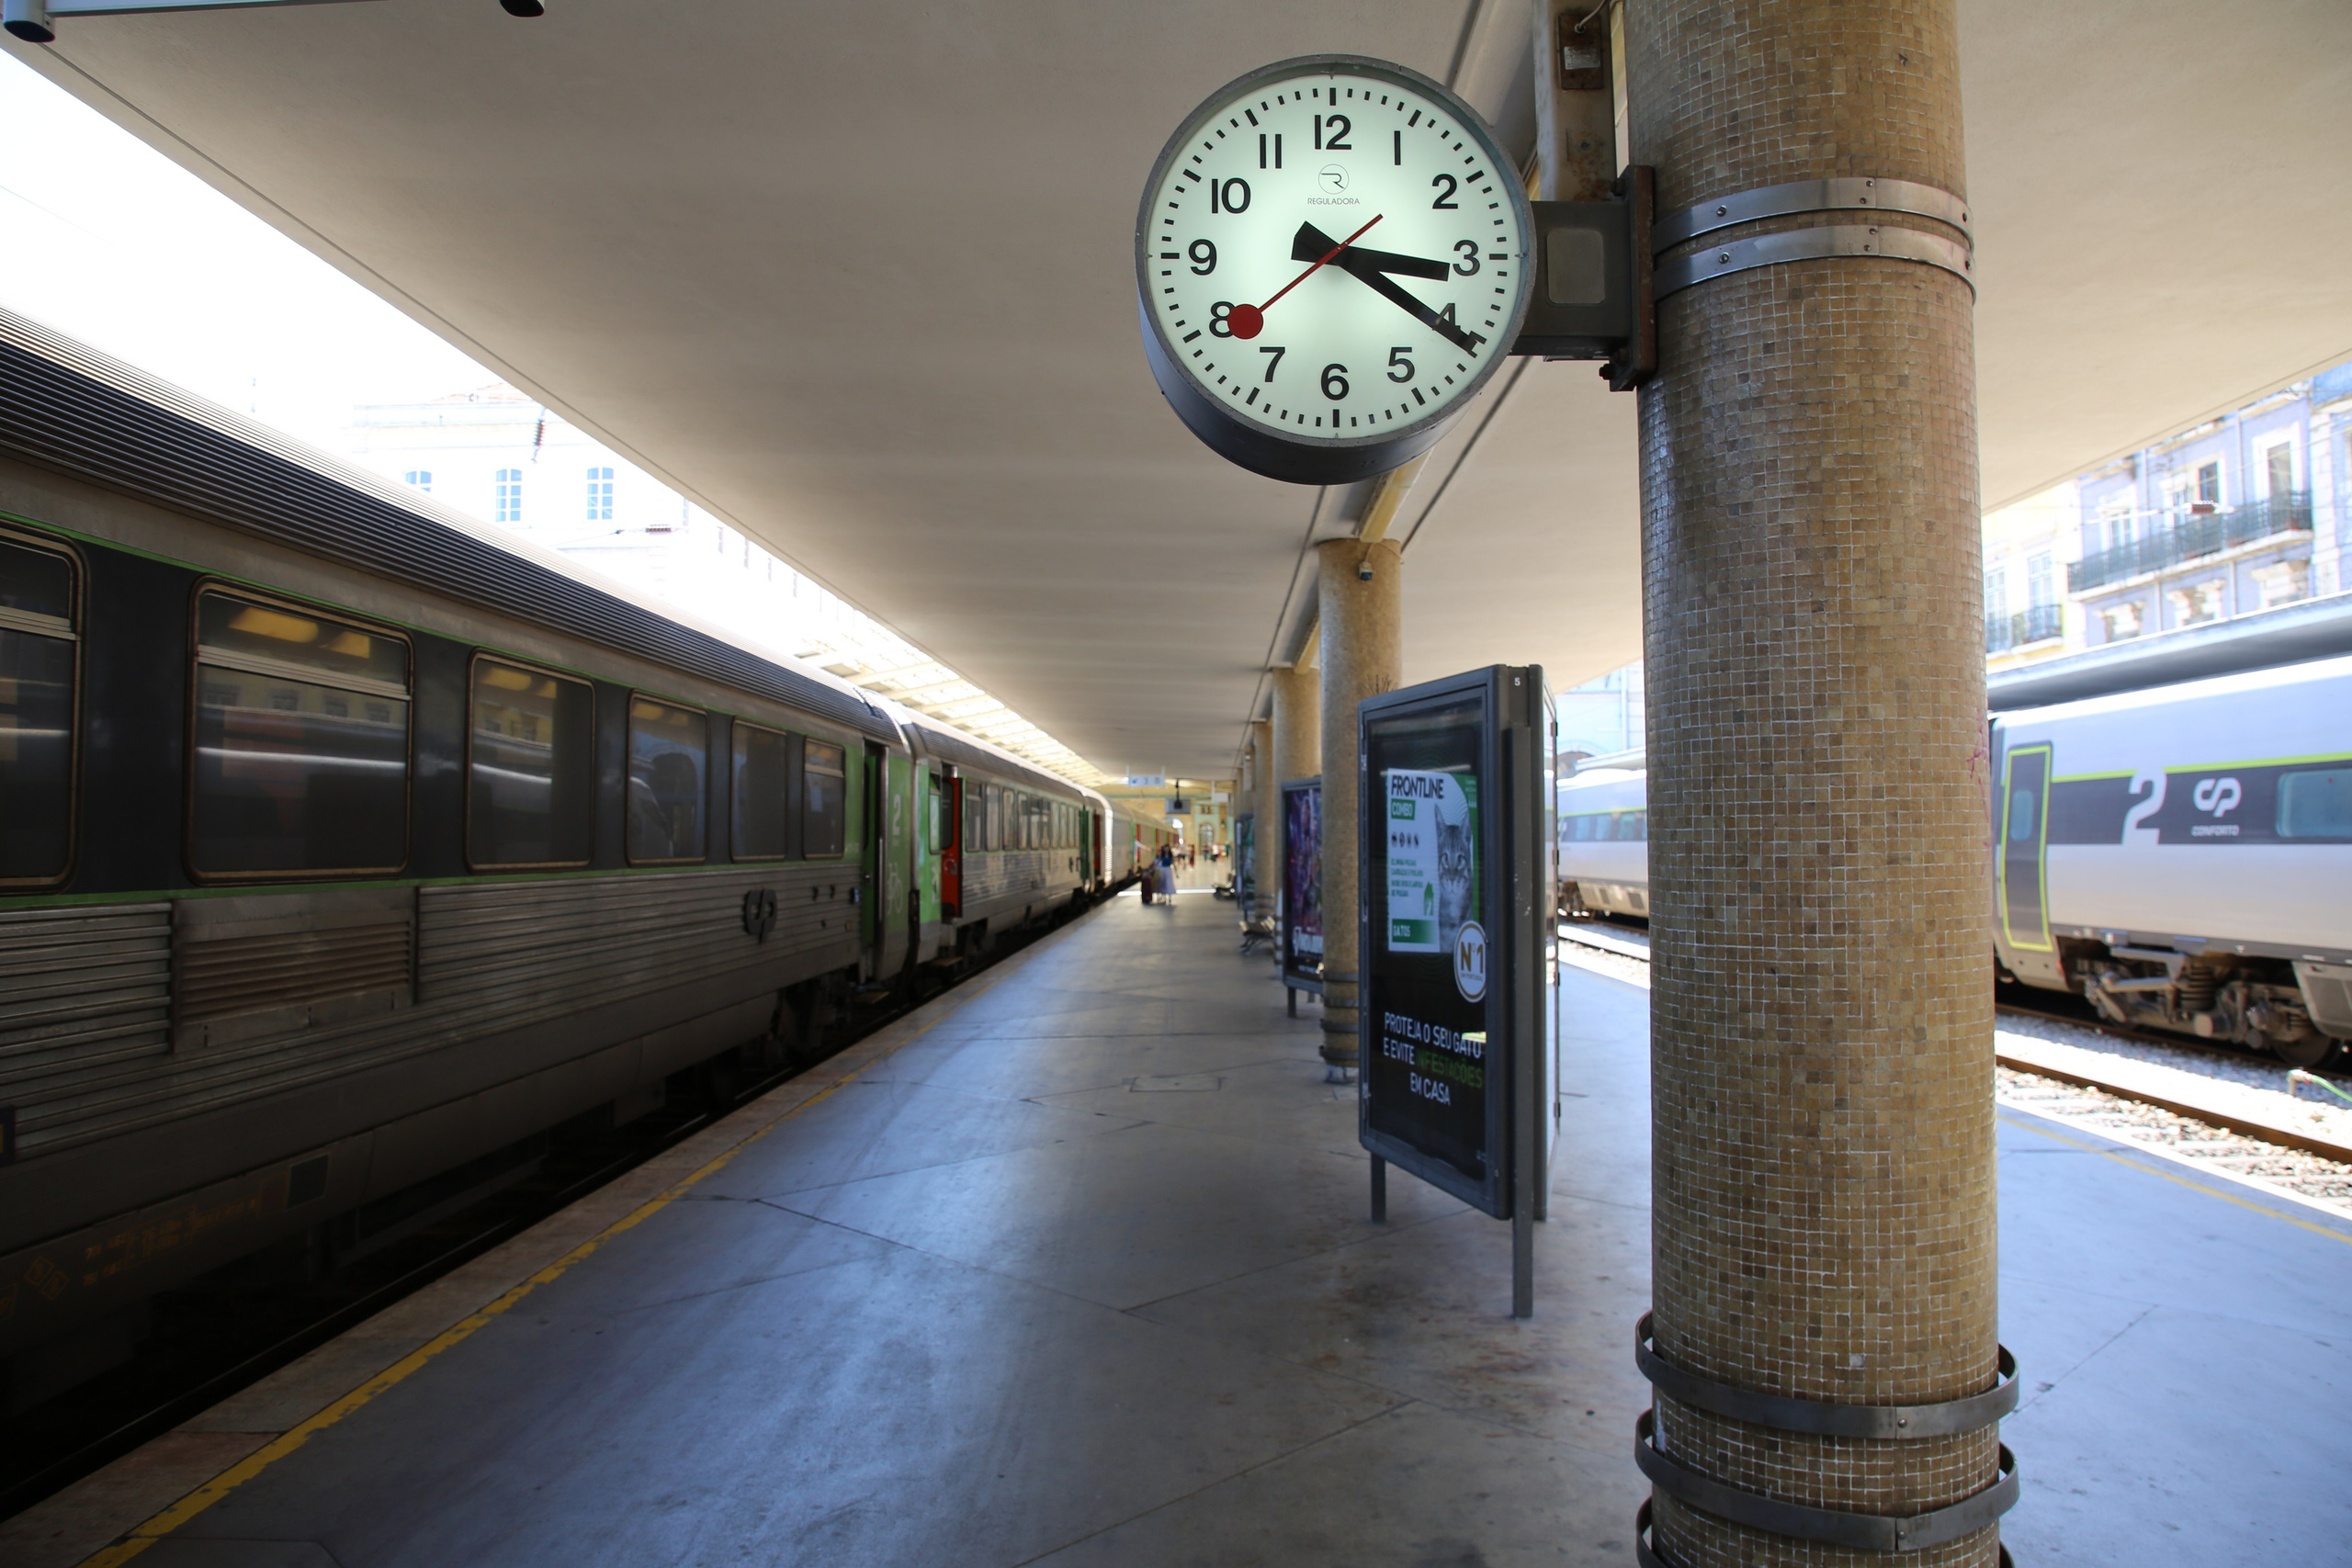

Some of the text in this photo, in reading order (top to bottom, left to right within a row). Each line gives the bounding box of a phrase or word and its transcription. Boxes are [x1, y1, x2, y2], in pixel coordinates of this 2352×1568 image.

[1259, 133, 1283, 169] 11
[1314, 114, 1352, 151] 12
[1394, 130, 1401, 165] 1
[1211, 177, 1251, 214] 10
[1306, 197, 1361, 206] REGULADORA
[1431, 173, 1459, 209] 2
[1188, 239, 1217, 276] 9
[1452, 239, 1481, 276] 3
[1208, 300, 1234, 338] 8
[1259, 346, 1285, 383] 7
[1320, 363, 1350, 400] 6
[1386, 346, 1415, 384] 5
[1391, 774, 1444, 800] FRONTLINE
[892, 793, 902, 836] 2
[1391, 801, 1414, 817] COMBO
[2121, 767, 2166, 845] 2
[1392, 924, 1411, 937] GATOS
[1383, 1036, 1390, 1056] E
[1390, 1038, 1416, 1066] EVITE
[1384, 1010, 1482, 1058] PROTEJA O SEU GATO
[1409, 1071, 1452, 1106] EM CASA
